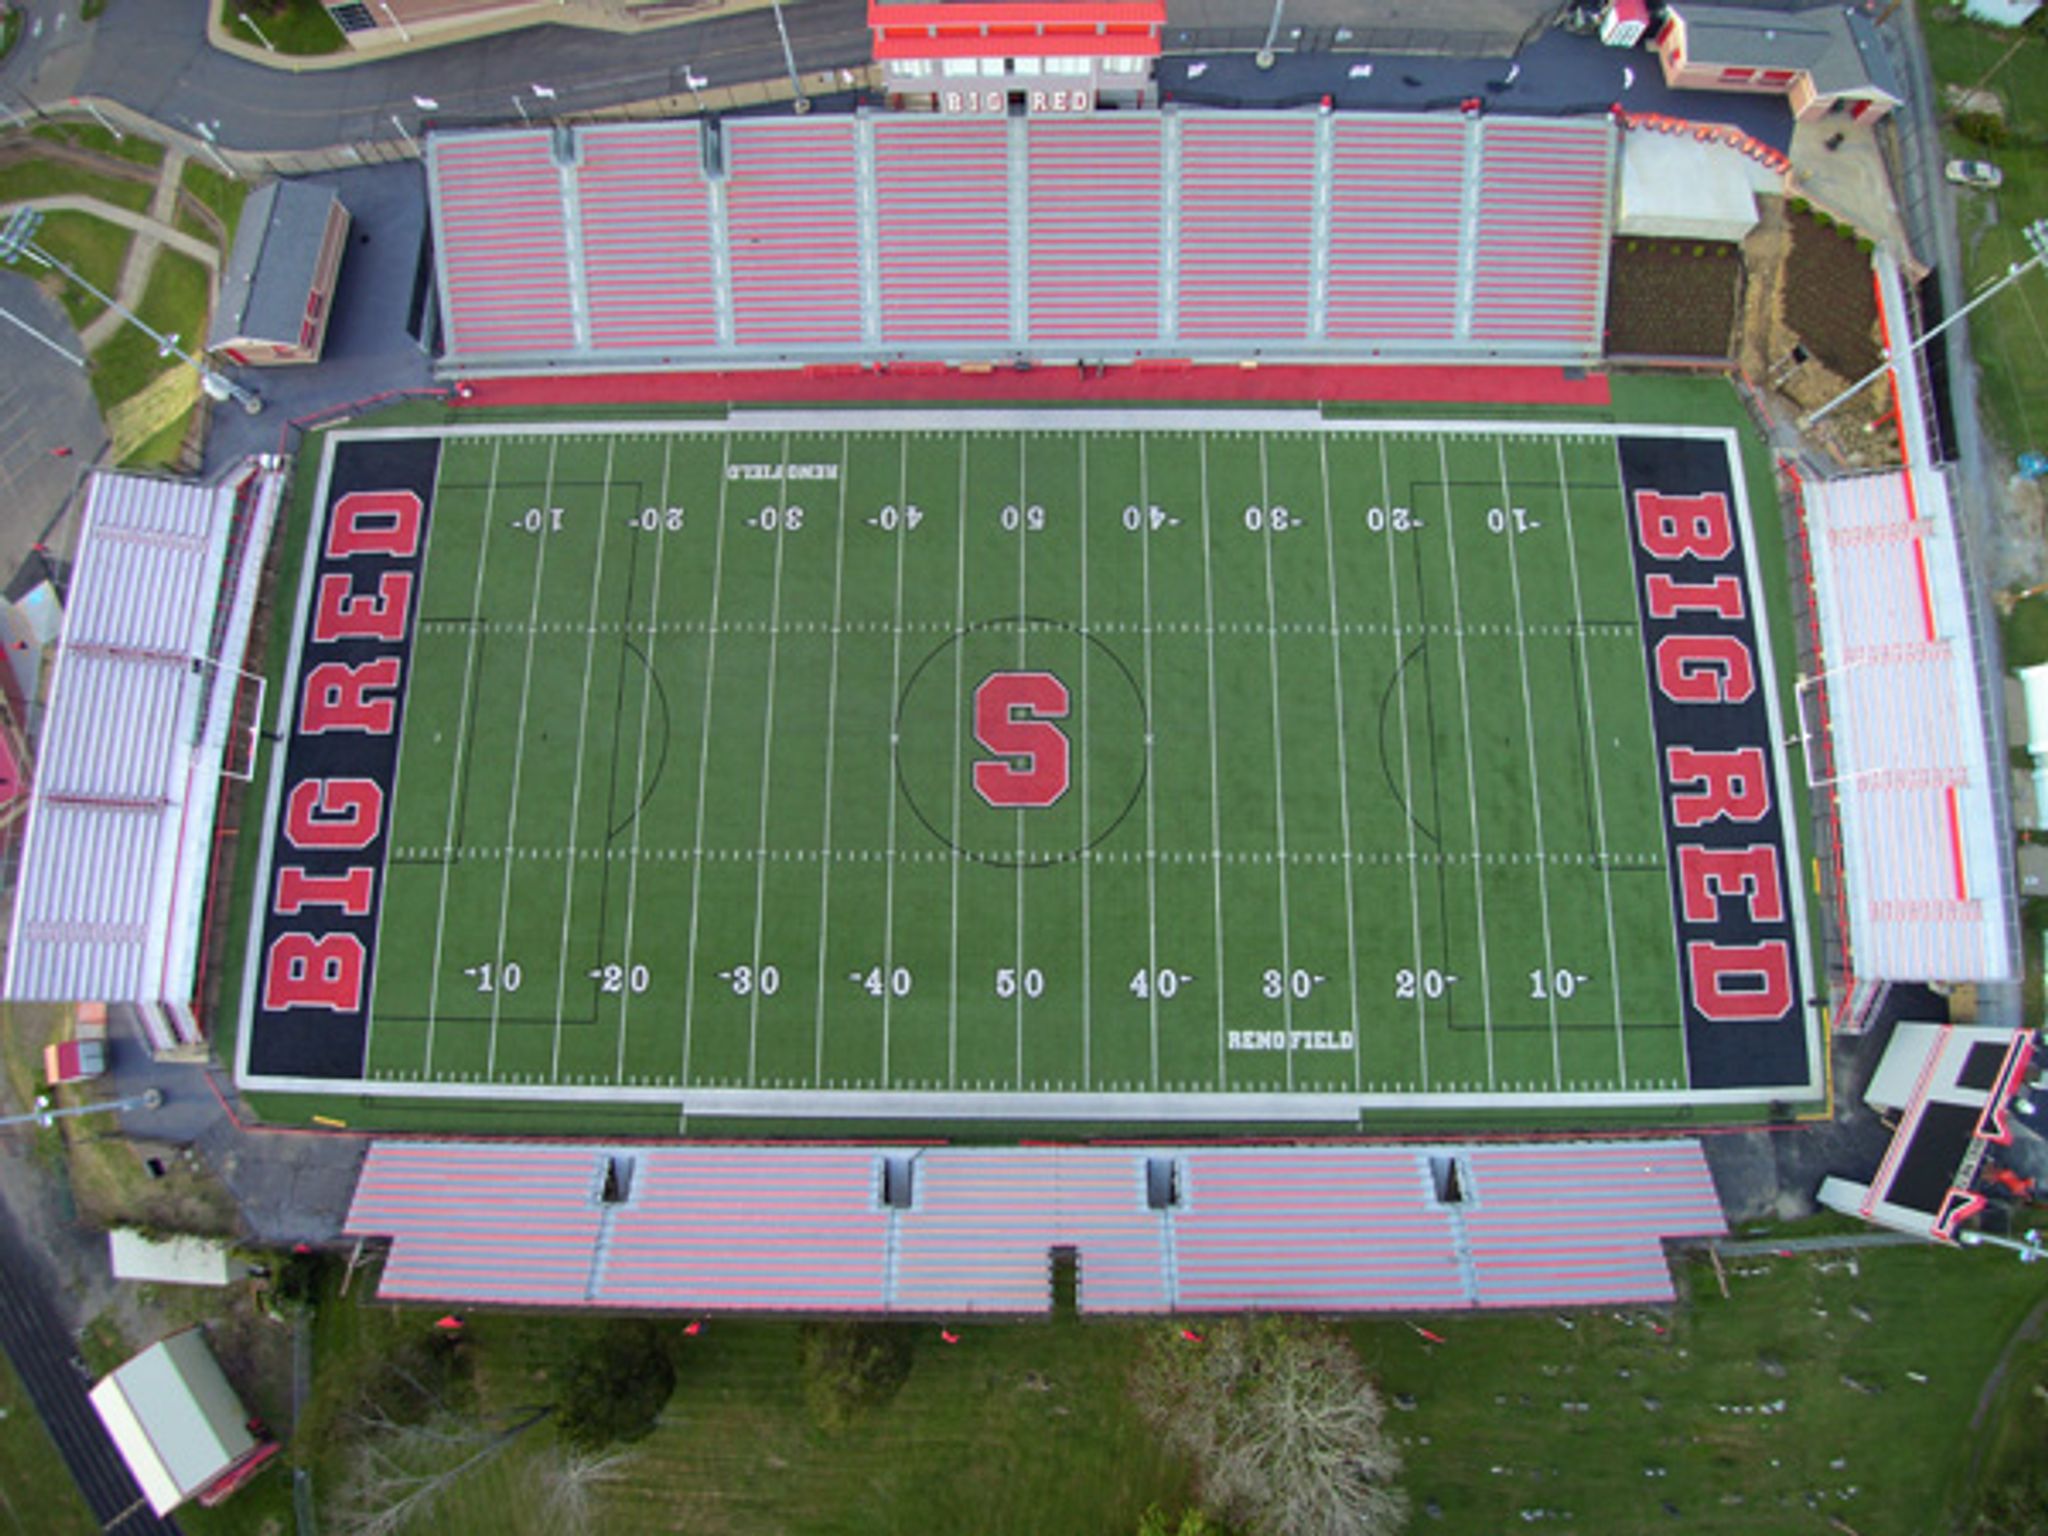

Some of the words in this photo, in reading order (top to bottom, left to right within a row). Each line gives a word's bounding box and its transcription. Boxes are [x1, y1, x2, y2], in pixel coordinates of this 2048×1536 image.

[944, 90, 1003, 112] BIG
[1032, 90, 1089, 112] RED
[727, 463, 783, 480] FIELD
[1002, 507, 1044, 530] 50
[299, 490, 424, 735] RED
[1634, 490, 1754, 704] BIG
[972, 672, 1070, 808] S
[263, 778, 385, 1013] BIG
[1666, 747, 1793, 1022] RED
[996, 968, 1044, 998] 50
[1228, 1030, 1285, 1050] RENO
[1288, 1030, 1354, 1050] FIELD
